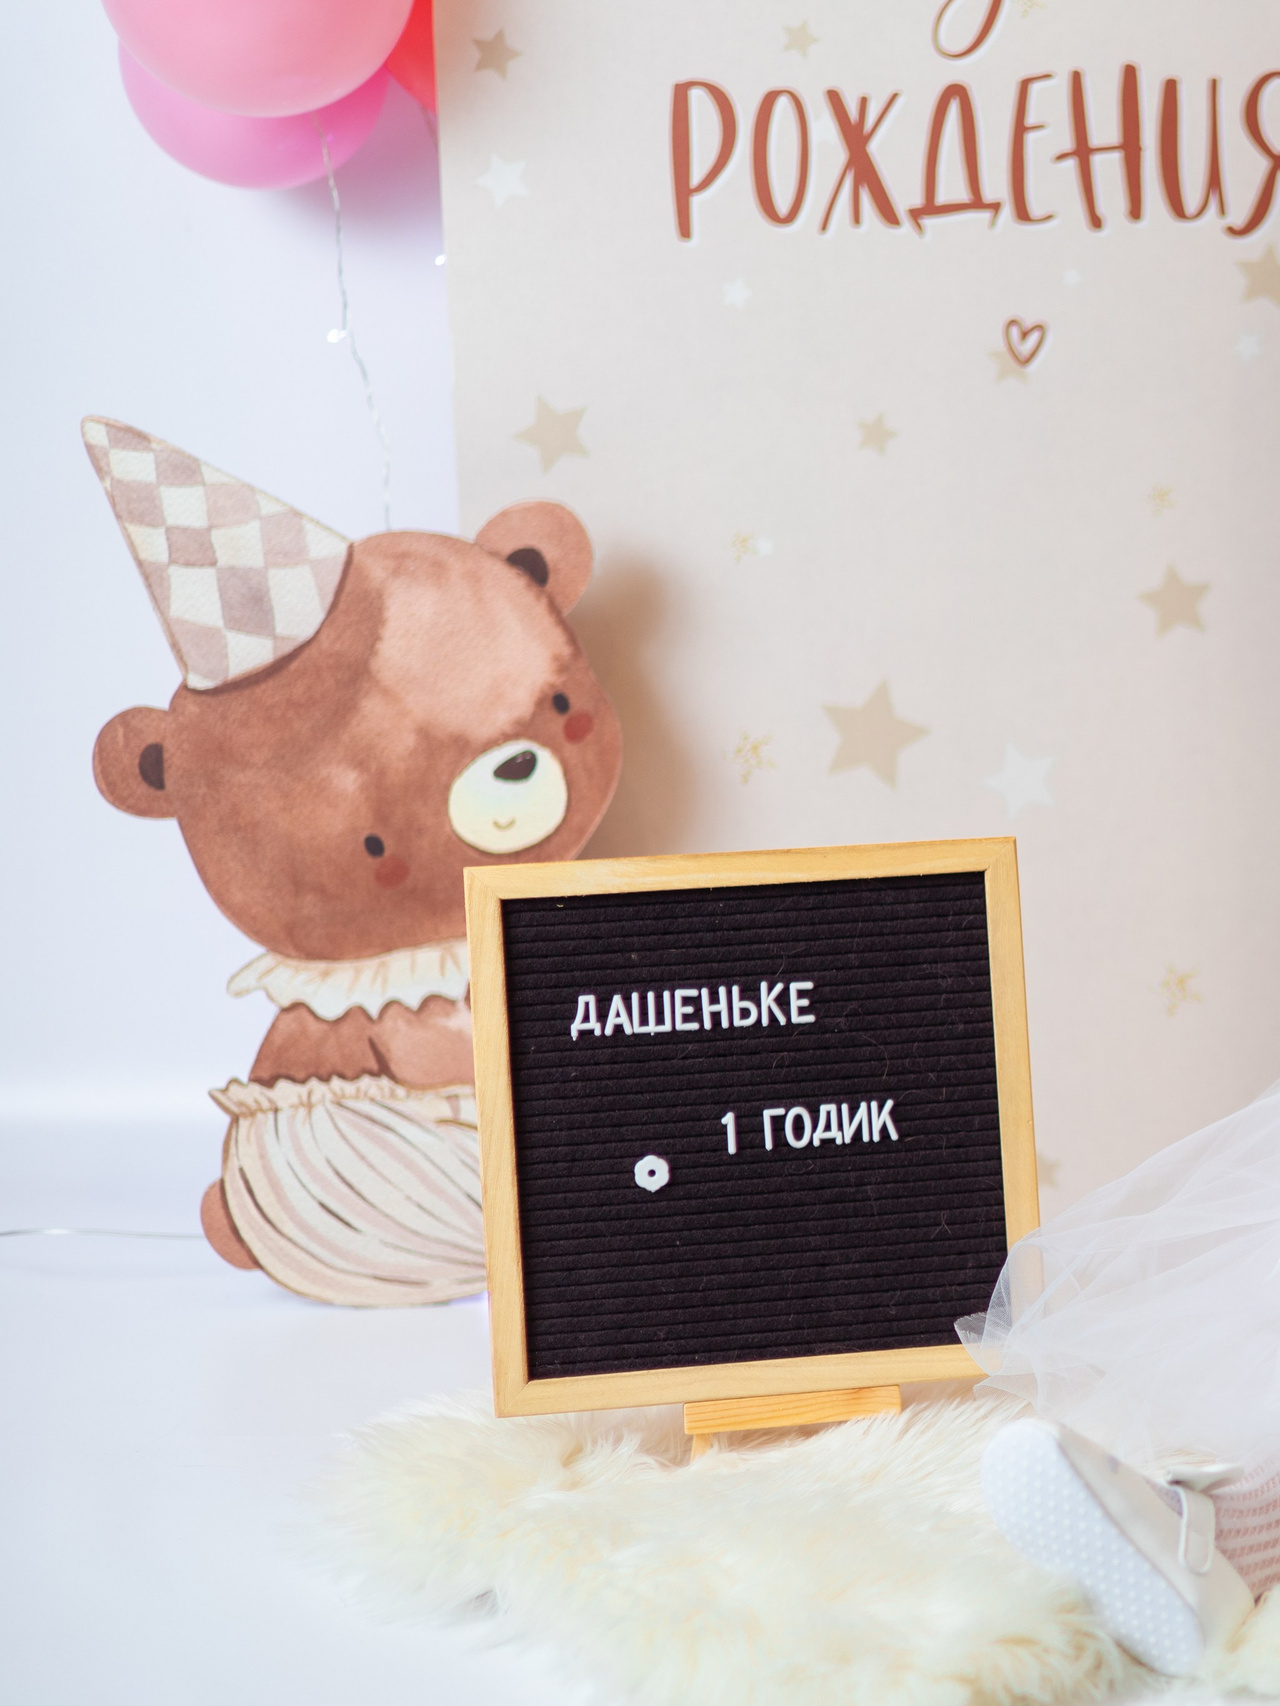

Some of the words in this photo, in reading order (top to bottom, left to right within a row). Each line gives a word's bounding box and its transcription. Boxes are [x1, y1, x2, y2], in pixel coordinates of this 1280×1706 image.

[570, 981, 816, 1041] ДАШЕНЬКЕ
[720, 1111, 738, 1155] 1
[762, 1098, 899, 1151] ГОДИК
